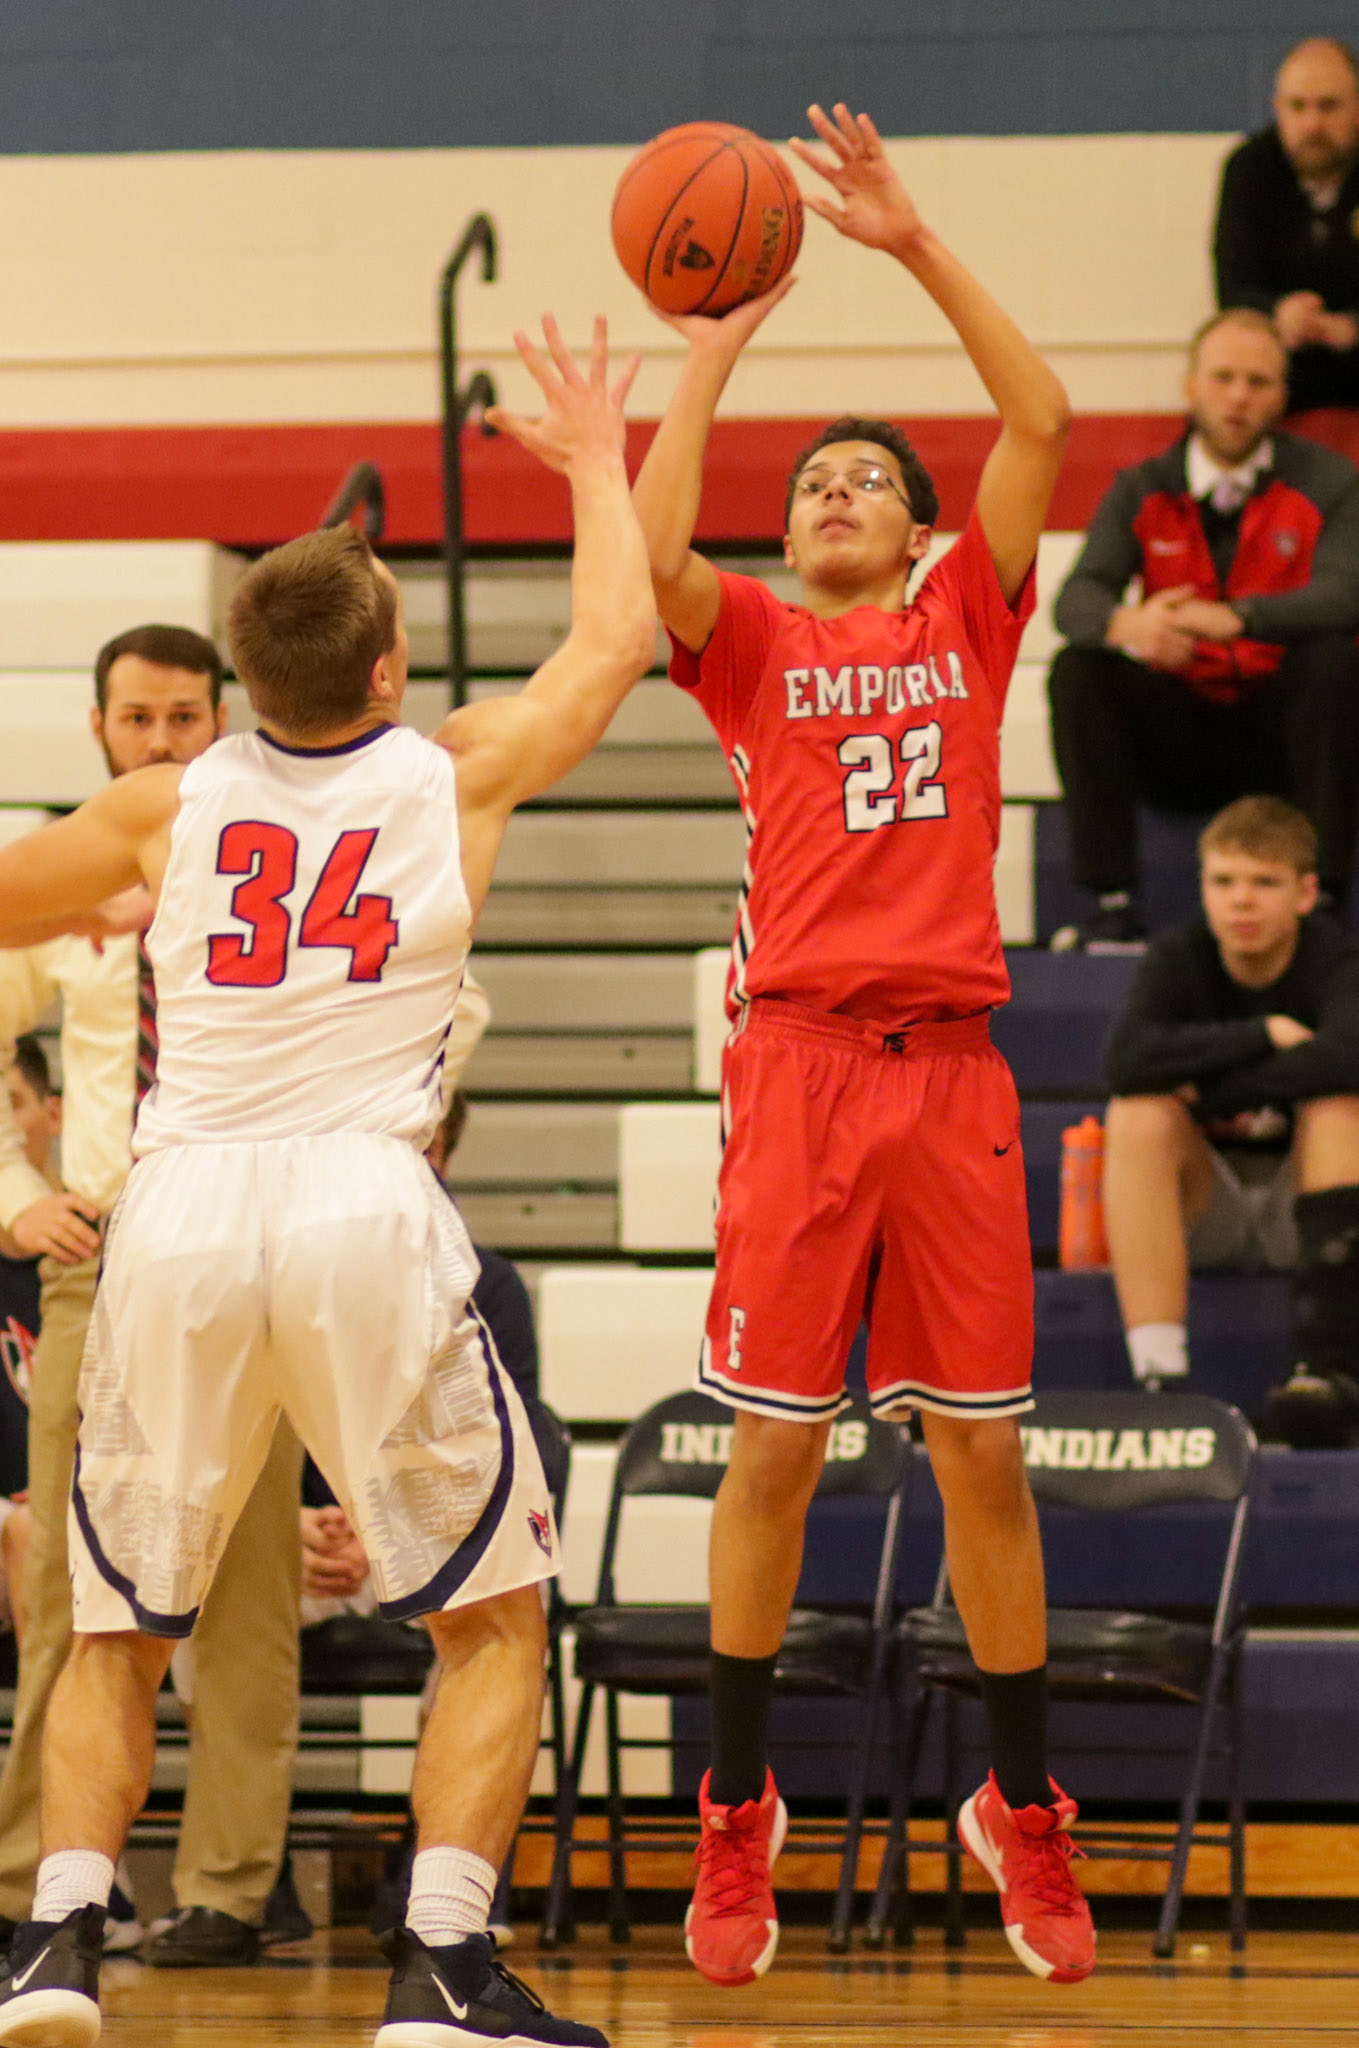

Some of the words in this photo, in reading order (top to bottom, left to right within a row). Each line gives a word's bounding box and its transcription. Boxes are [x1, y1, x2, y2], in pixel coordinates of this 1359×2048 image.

[784, 651, 970, 719] EMPORIA
[837, 719, 948, 833] 22
[205, 819, 399, 988] 34
[727, 1305, 746, 1372] E
